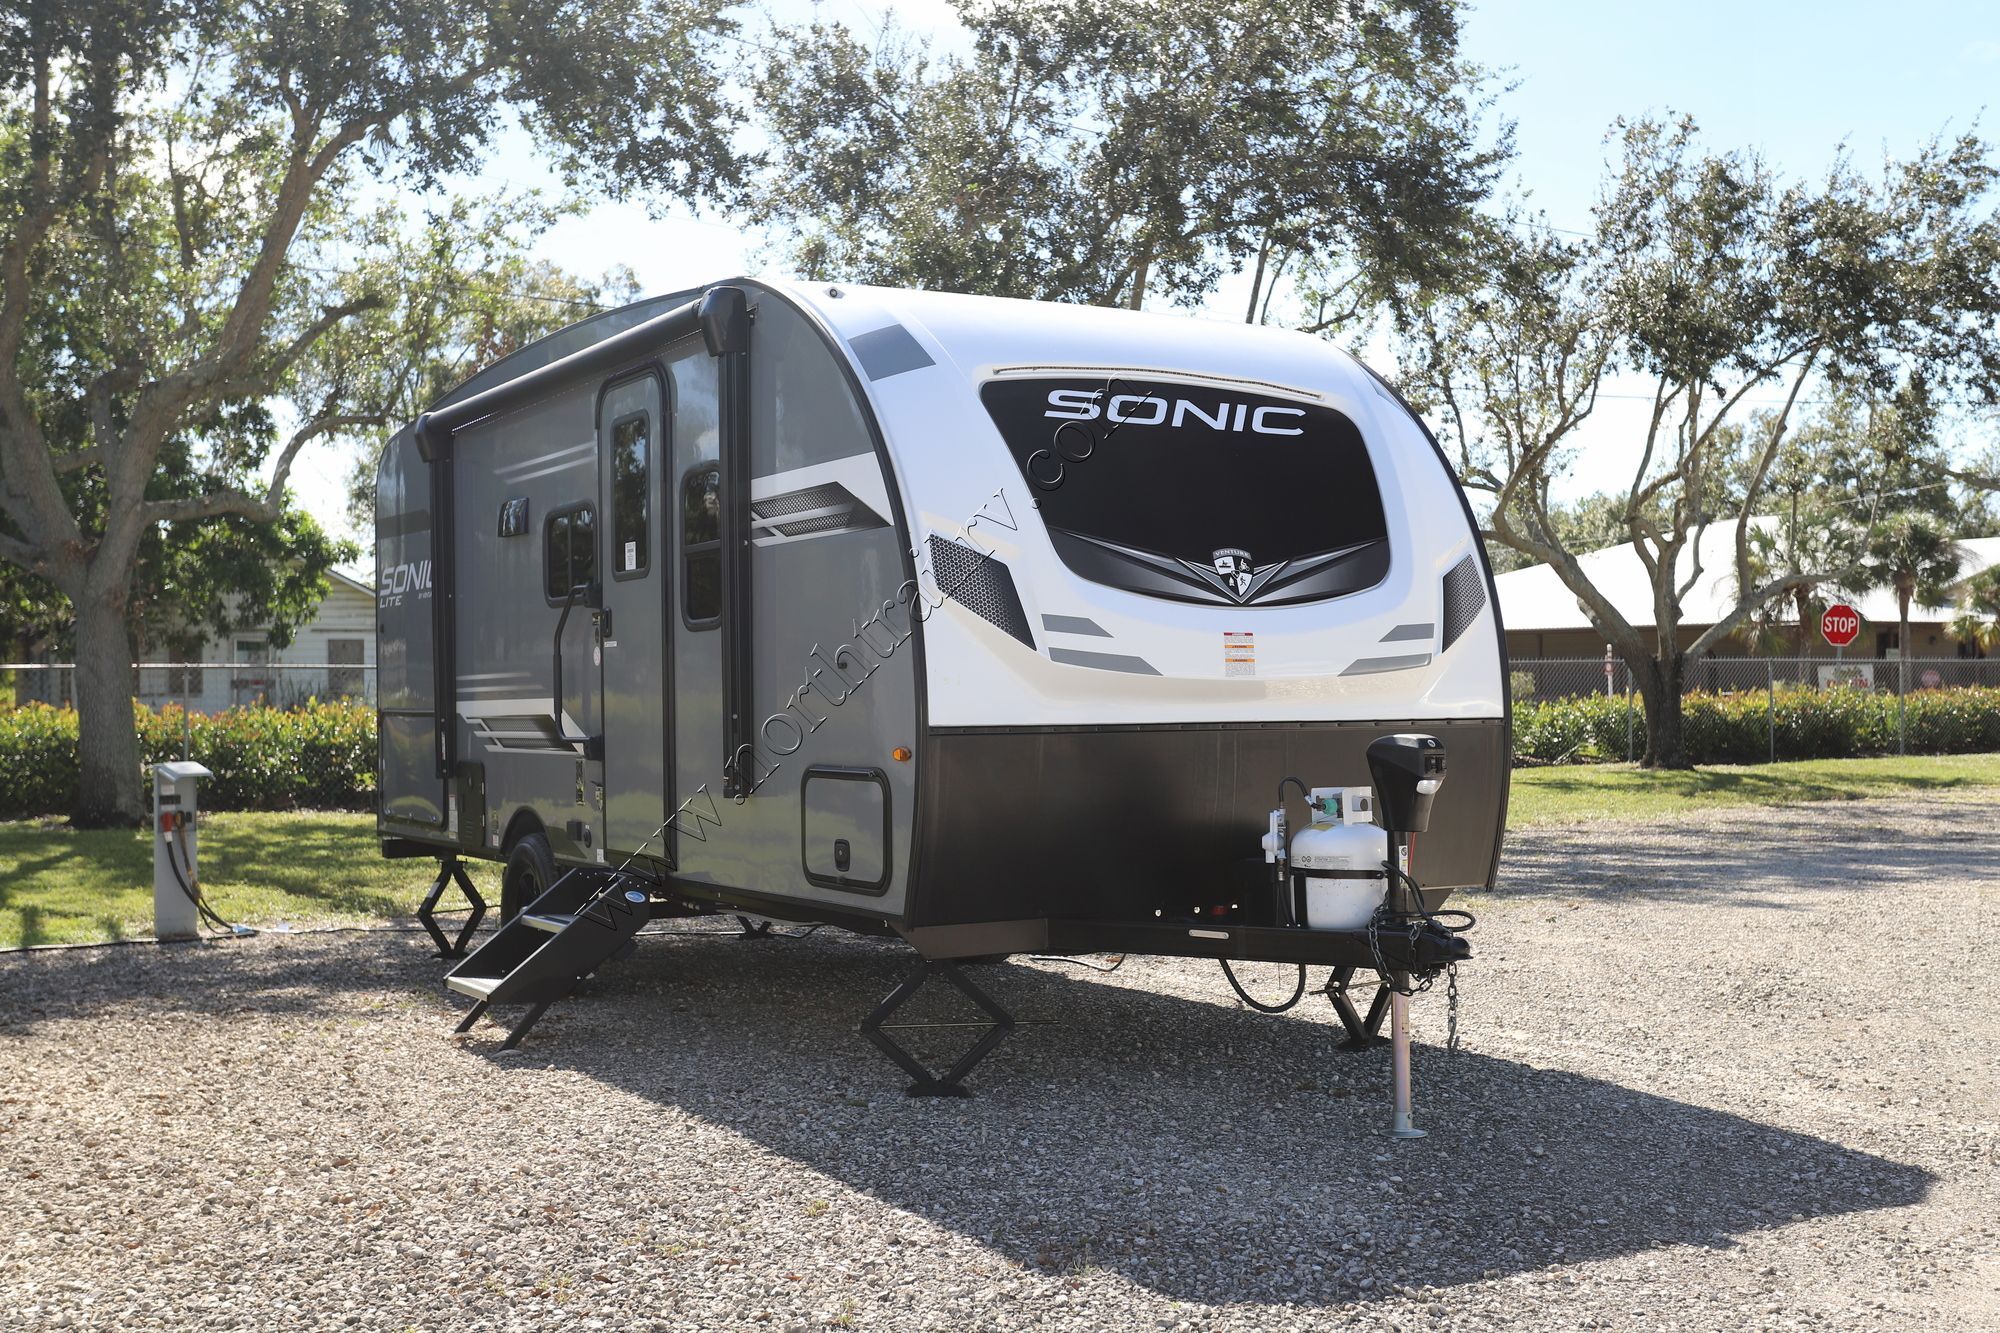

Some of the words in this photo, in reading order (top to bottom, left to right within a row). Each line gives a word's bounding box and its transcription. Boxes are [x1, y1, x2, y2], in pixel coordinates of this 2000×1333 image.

[1044, 389, 1307, 436] SONIC
[380, 595, 402, 608] LITE
[1824, 616, 1857, 633] STOP
